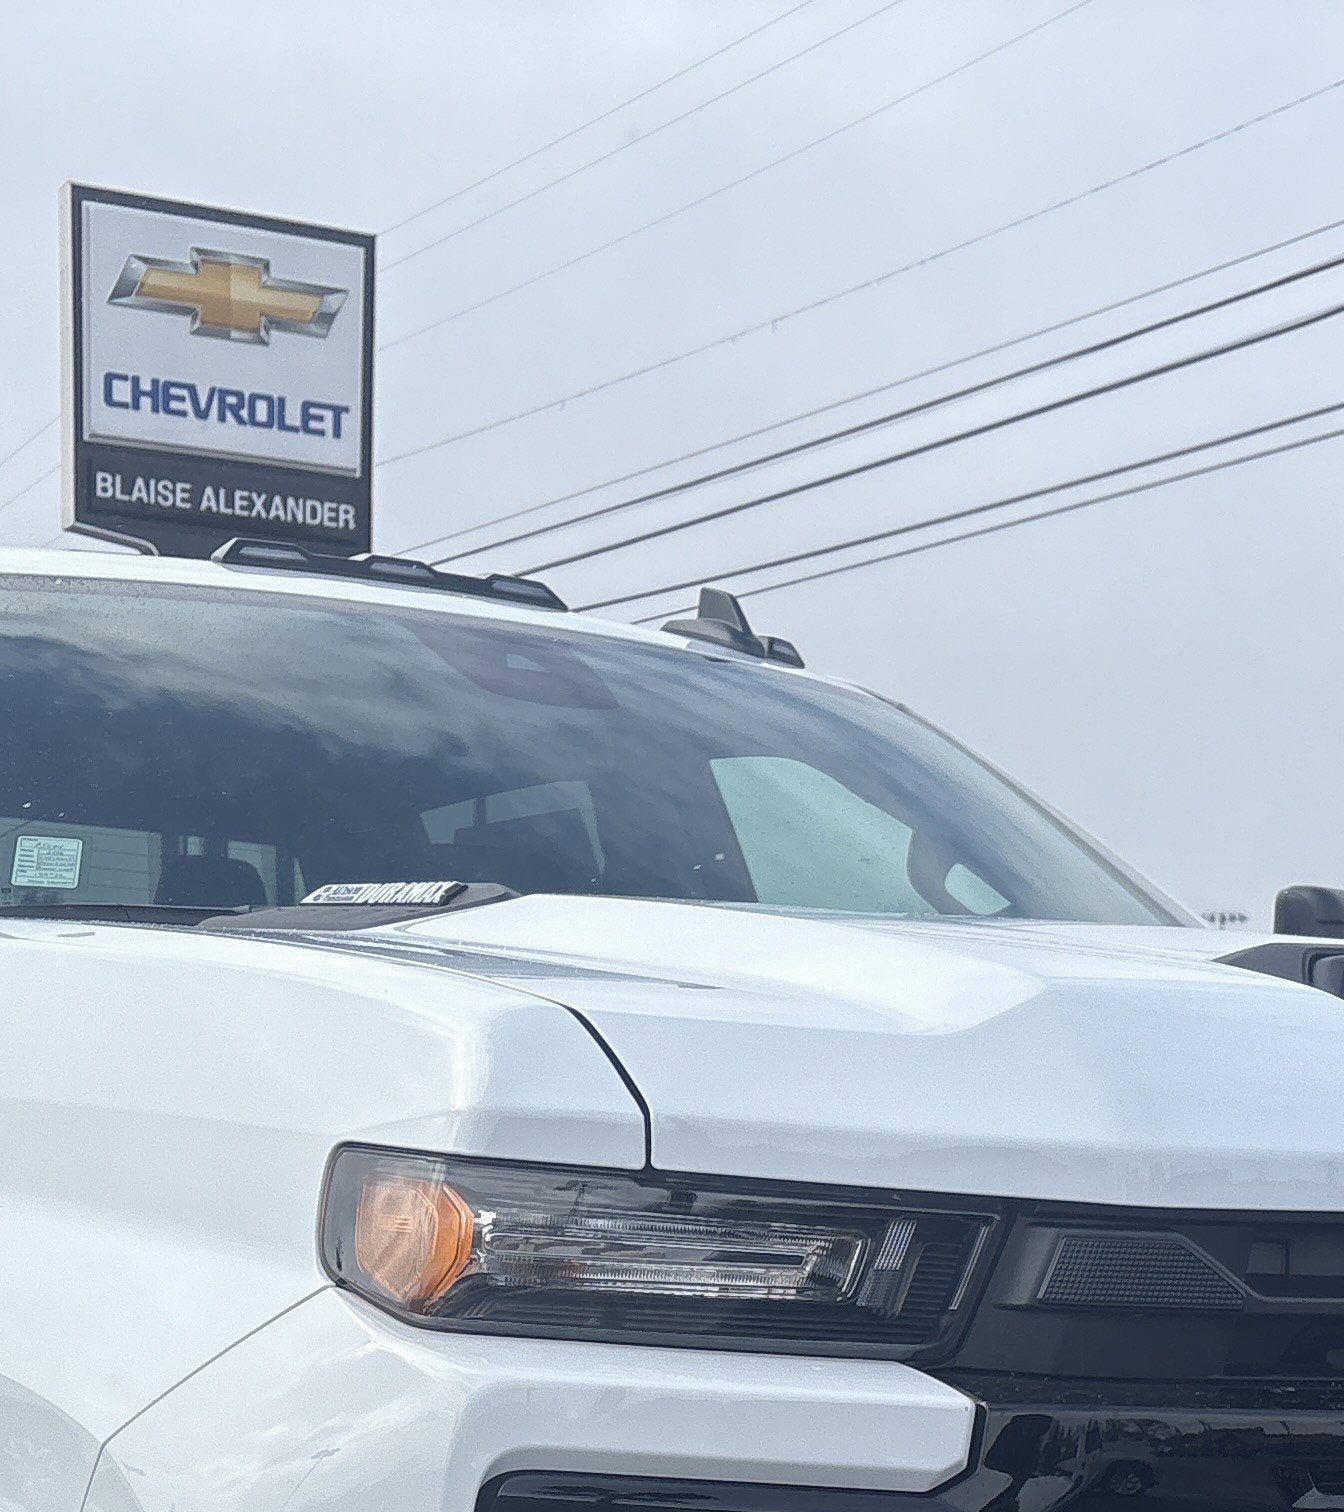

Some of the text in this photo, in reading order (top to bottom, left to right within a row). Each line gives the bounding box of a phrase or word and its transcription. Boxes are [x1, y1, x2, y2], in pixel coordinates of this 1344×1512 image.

[102, 370, 351, 440] CHEVROLET
[94, 471, 357, 531] BLAISE ALEXANDER
